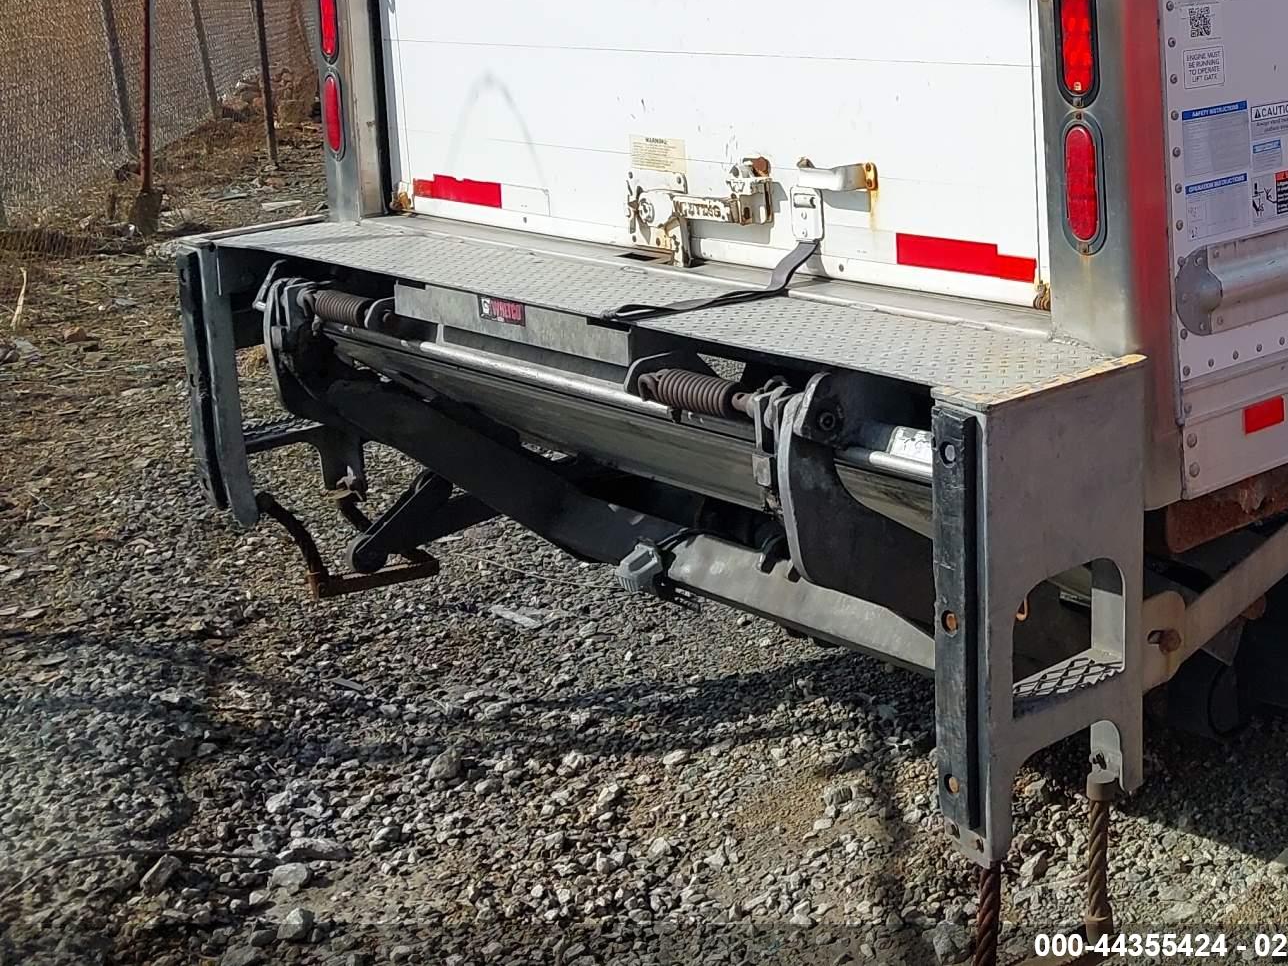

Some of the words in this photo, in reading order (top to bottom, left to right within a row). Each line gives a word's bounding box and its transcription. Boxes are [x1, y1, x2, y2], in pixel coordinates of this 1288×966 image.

[1195, 58, 1220, 68] RUNNING
[1188, 68, 1197, 76] TO
[1197, 65, 1221, 75] OPERATE
[1191, 75, 1203, 83] LIFT
